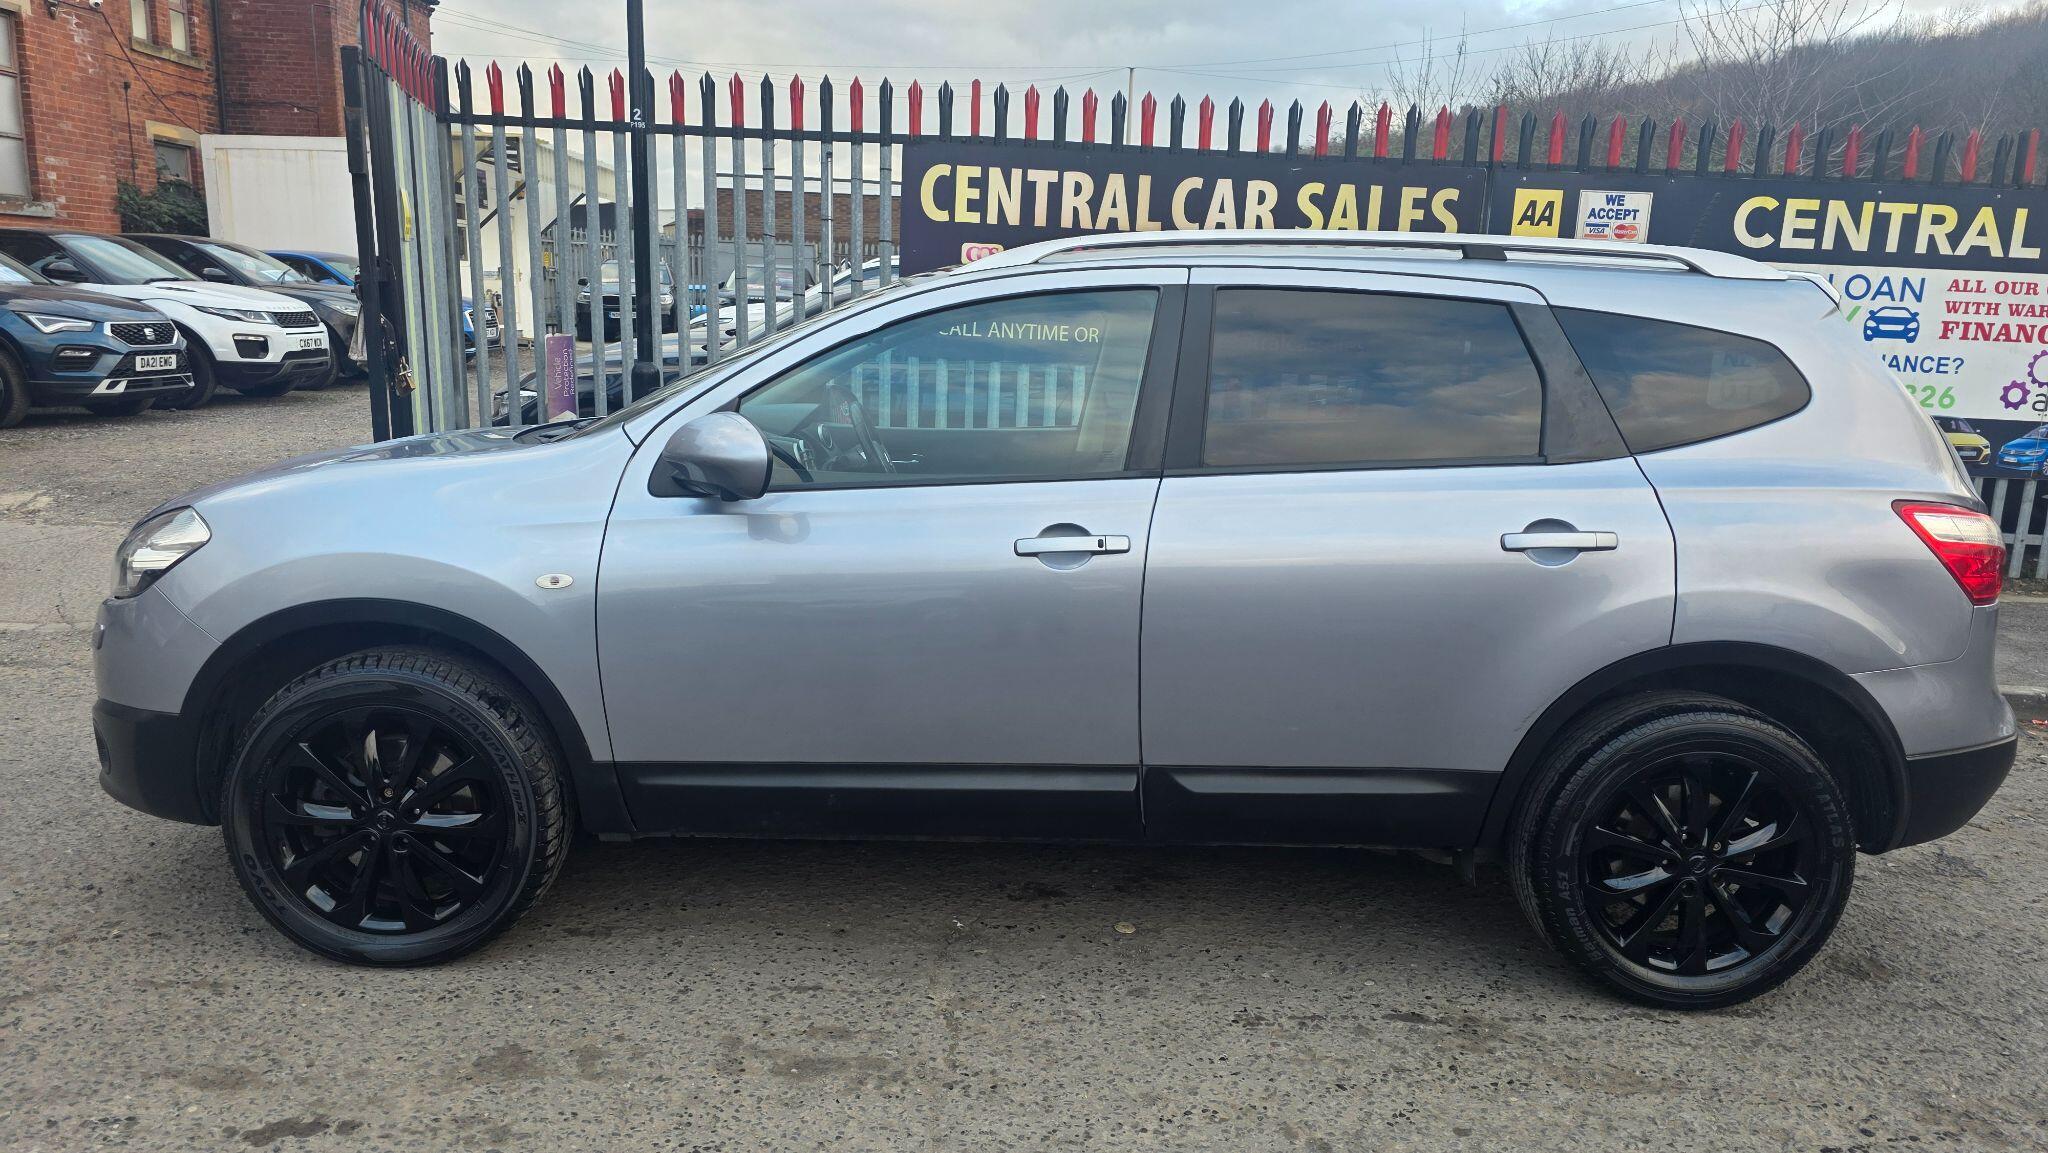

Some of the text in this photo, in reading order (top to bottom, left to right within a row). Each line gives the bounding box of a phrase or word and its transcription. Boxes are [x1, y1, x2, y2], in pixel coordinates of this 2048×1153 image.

[632, 108, 641, 120] 2
[920, 163, 1460, 233] CENTRAL CAR SALES
[1606, 194, 1625, 206] WE
[1517, 200, 1555, 226] AA
[1587, 208, 1639, 220] ACCEPT
[1733, 196, 2040, 259] CENTRAL
[1947, 279, 1986, 293] ALL
[1995, 281, 2039, 295] OUR
[1945, 300, 2001, 316] WITH
[940, 322, 1099, 342] ALL ANYTIME OR
[140, 356, 172, 368] DA21 EWG
[1882, 354, 1964, 374] ANCE?
